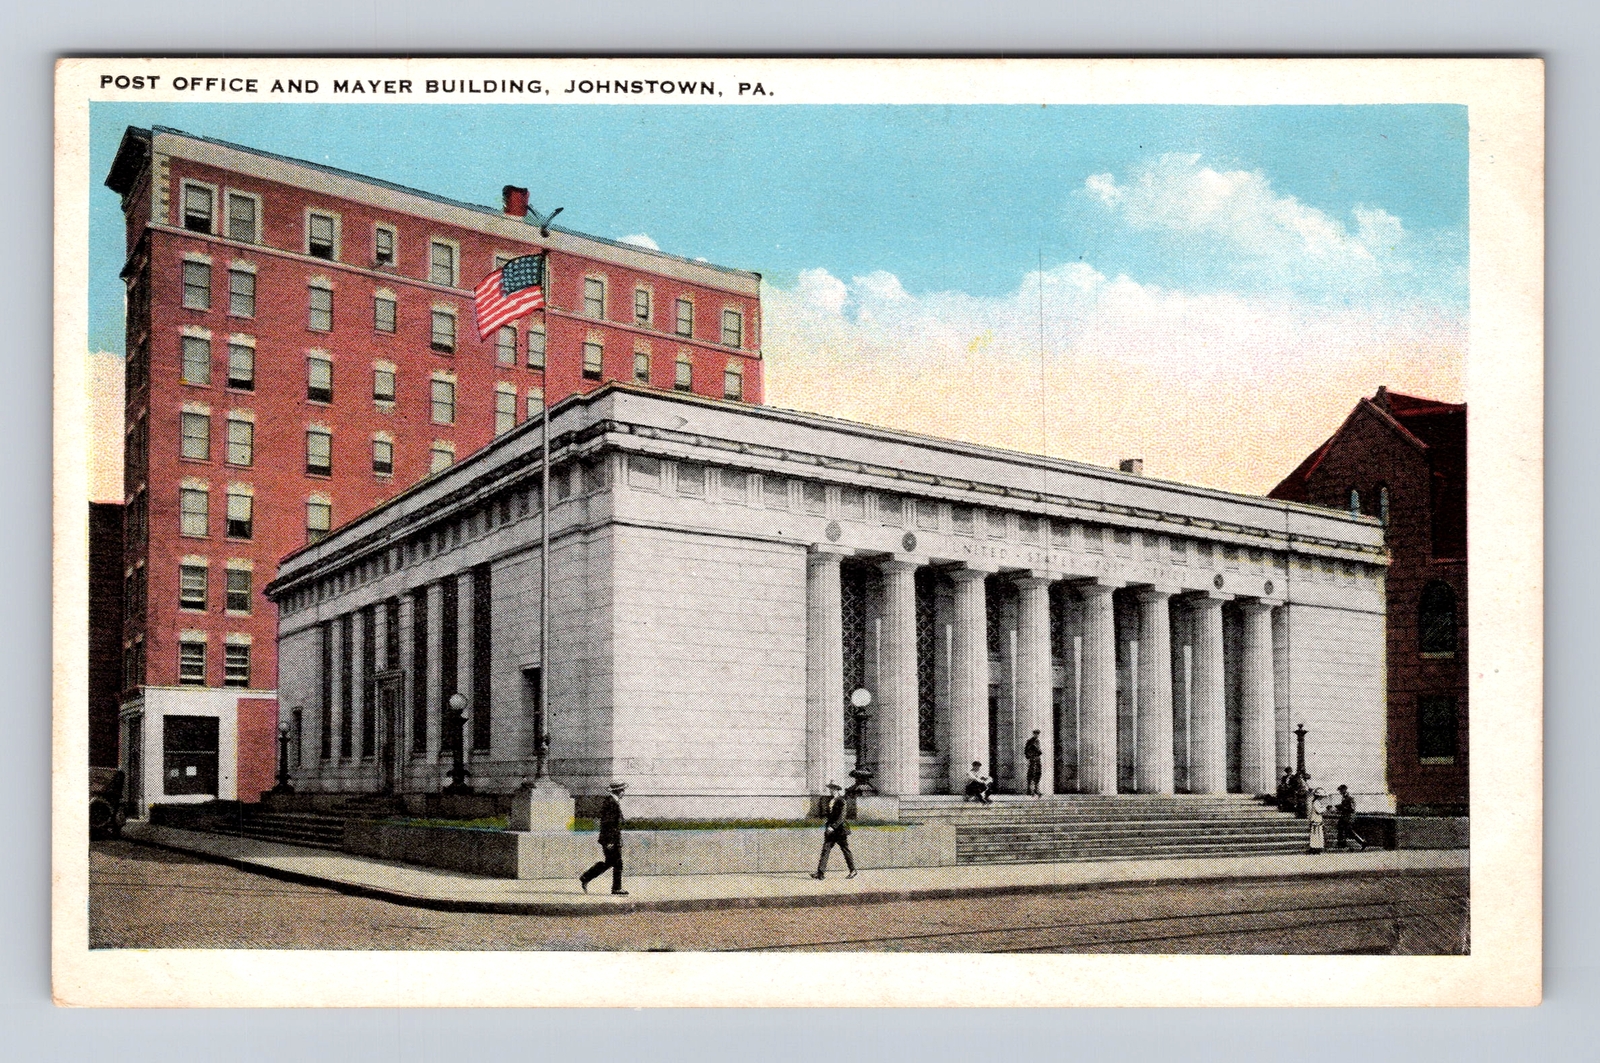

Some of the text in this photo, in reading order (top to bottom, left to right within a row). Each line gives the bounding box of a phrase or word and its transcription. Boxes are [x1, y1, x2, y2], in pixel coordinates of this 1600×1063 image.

[100, 75, 774, 97] POST OFFICE AND MAYER BUILDING, JOHNSTOWN, PA.
